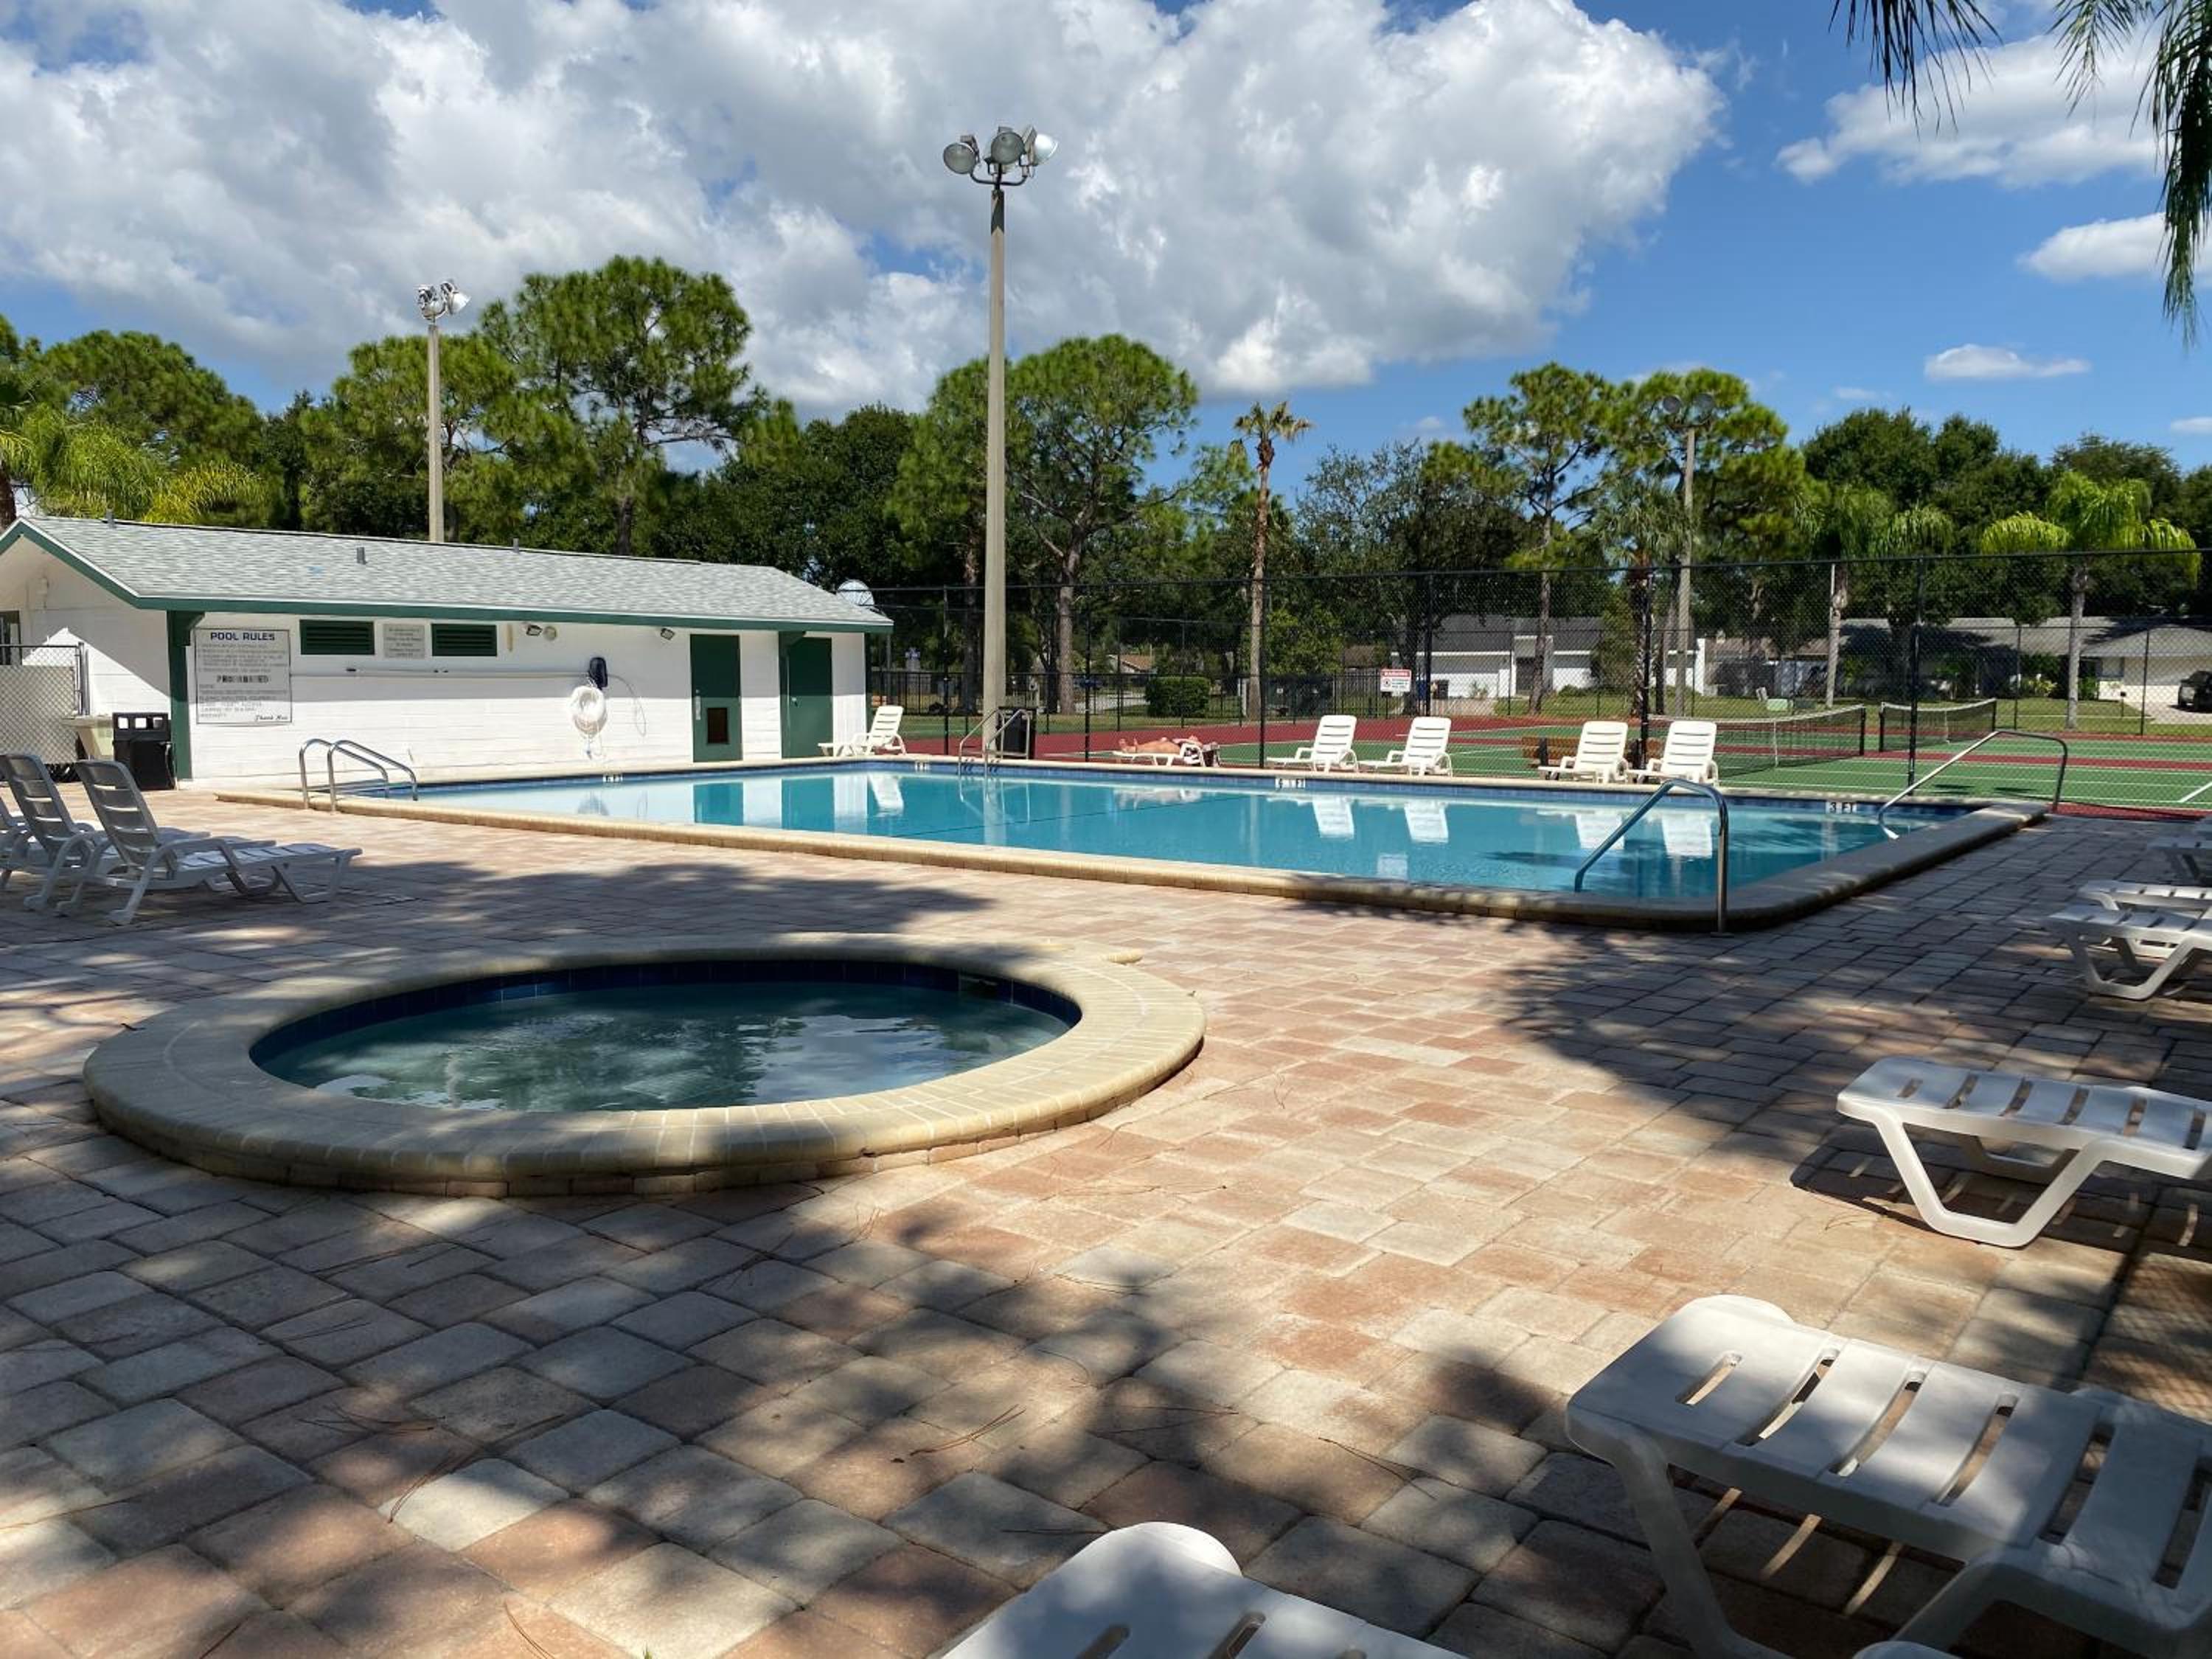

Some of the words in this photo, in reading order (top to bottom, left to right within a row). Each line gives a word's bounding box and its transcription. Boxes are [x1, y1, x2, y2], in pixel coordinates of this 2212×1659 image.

[210, 632, 239, 641] POOL
[243, 632, 275, 641] RULES
[1829, 802, 1837, 813] 3
[1842, 802, 1854, 814] FT
